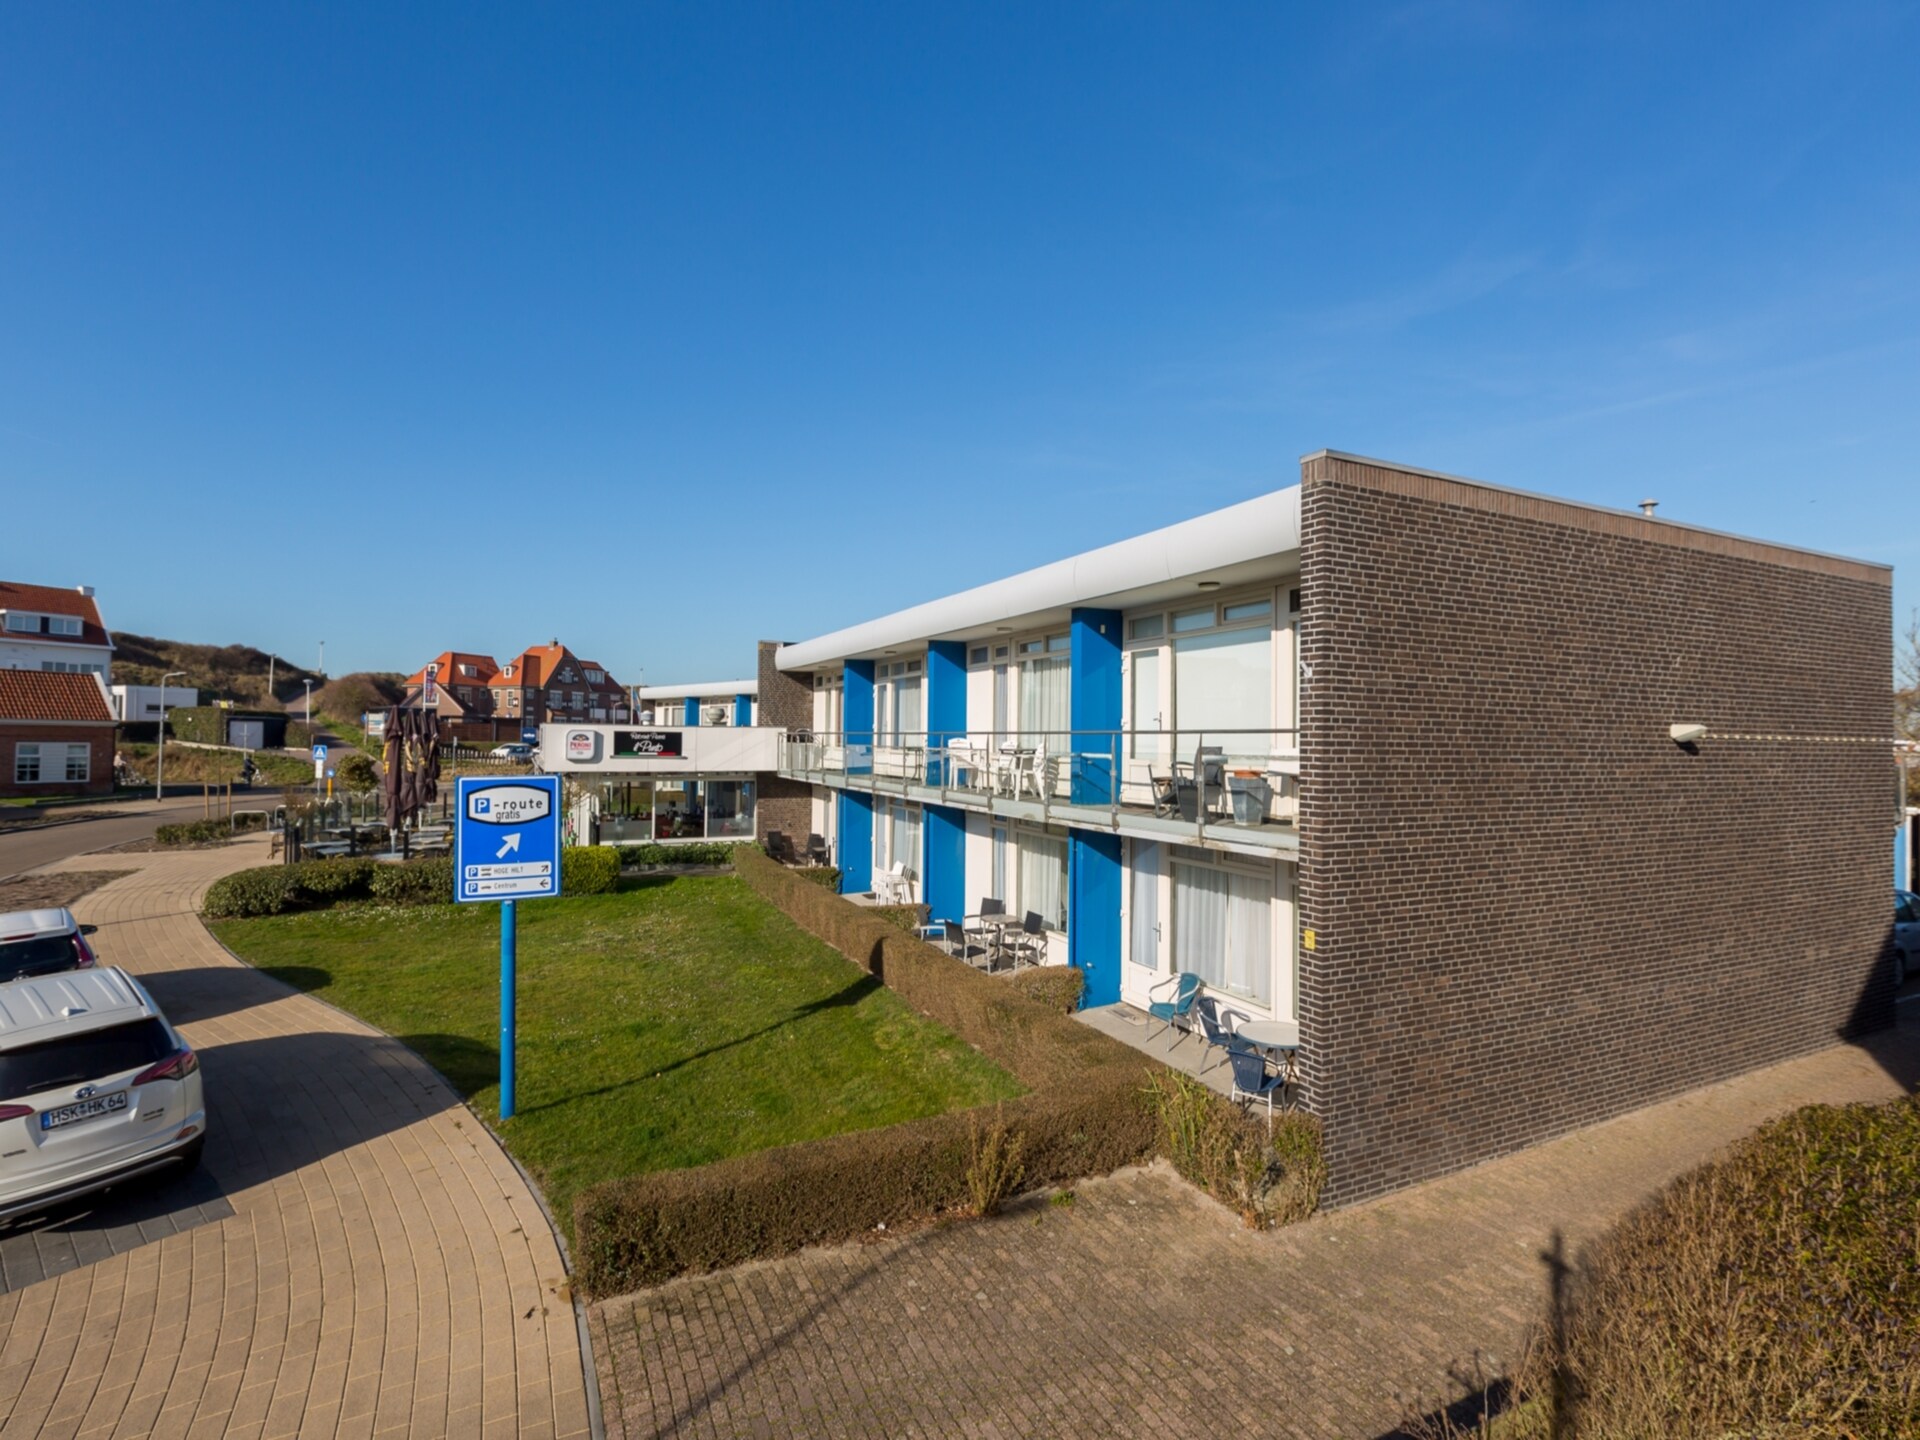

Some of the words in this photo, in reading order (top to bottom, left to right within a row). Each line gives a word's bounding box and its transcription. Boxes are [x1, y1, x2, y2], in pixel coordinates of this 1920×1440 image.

[477, 799, 488, 813] P
[495, 810, 521, 822] gratis
[51, 1106, 79, 1123] HSK
[88, 1099, 105, 1113] HK
[108, 1094, 124, 1107] 64
